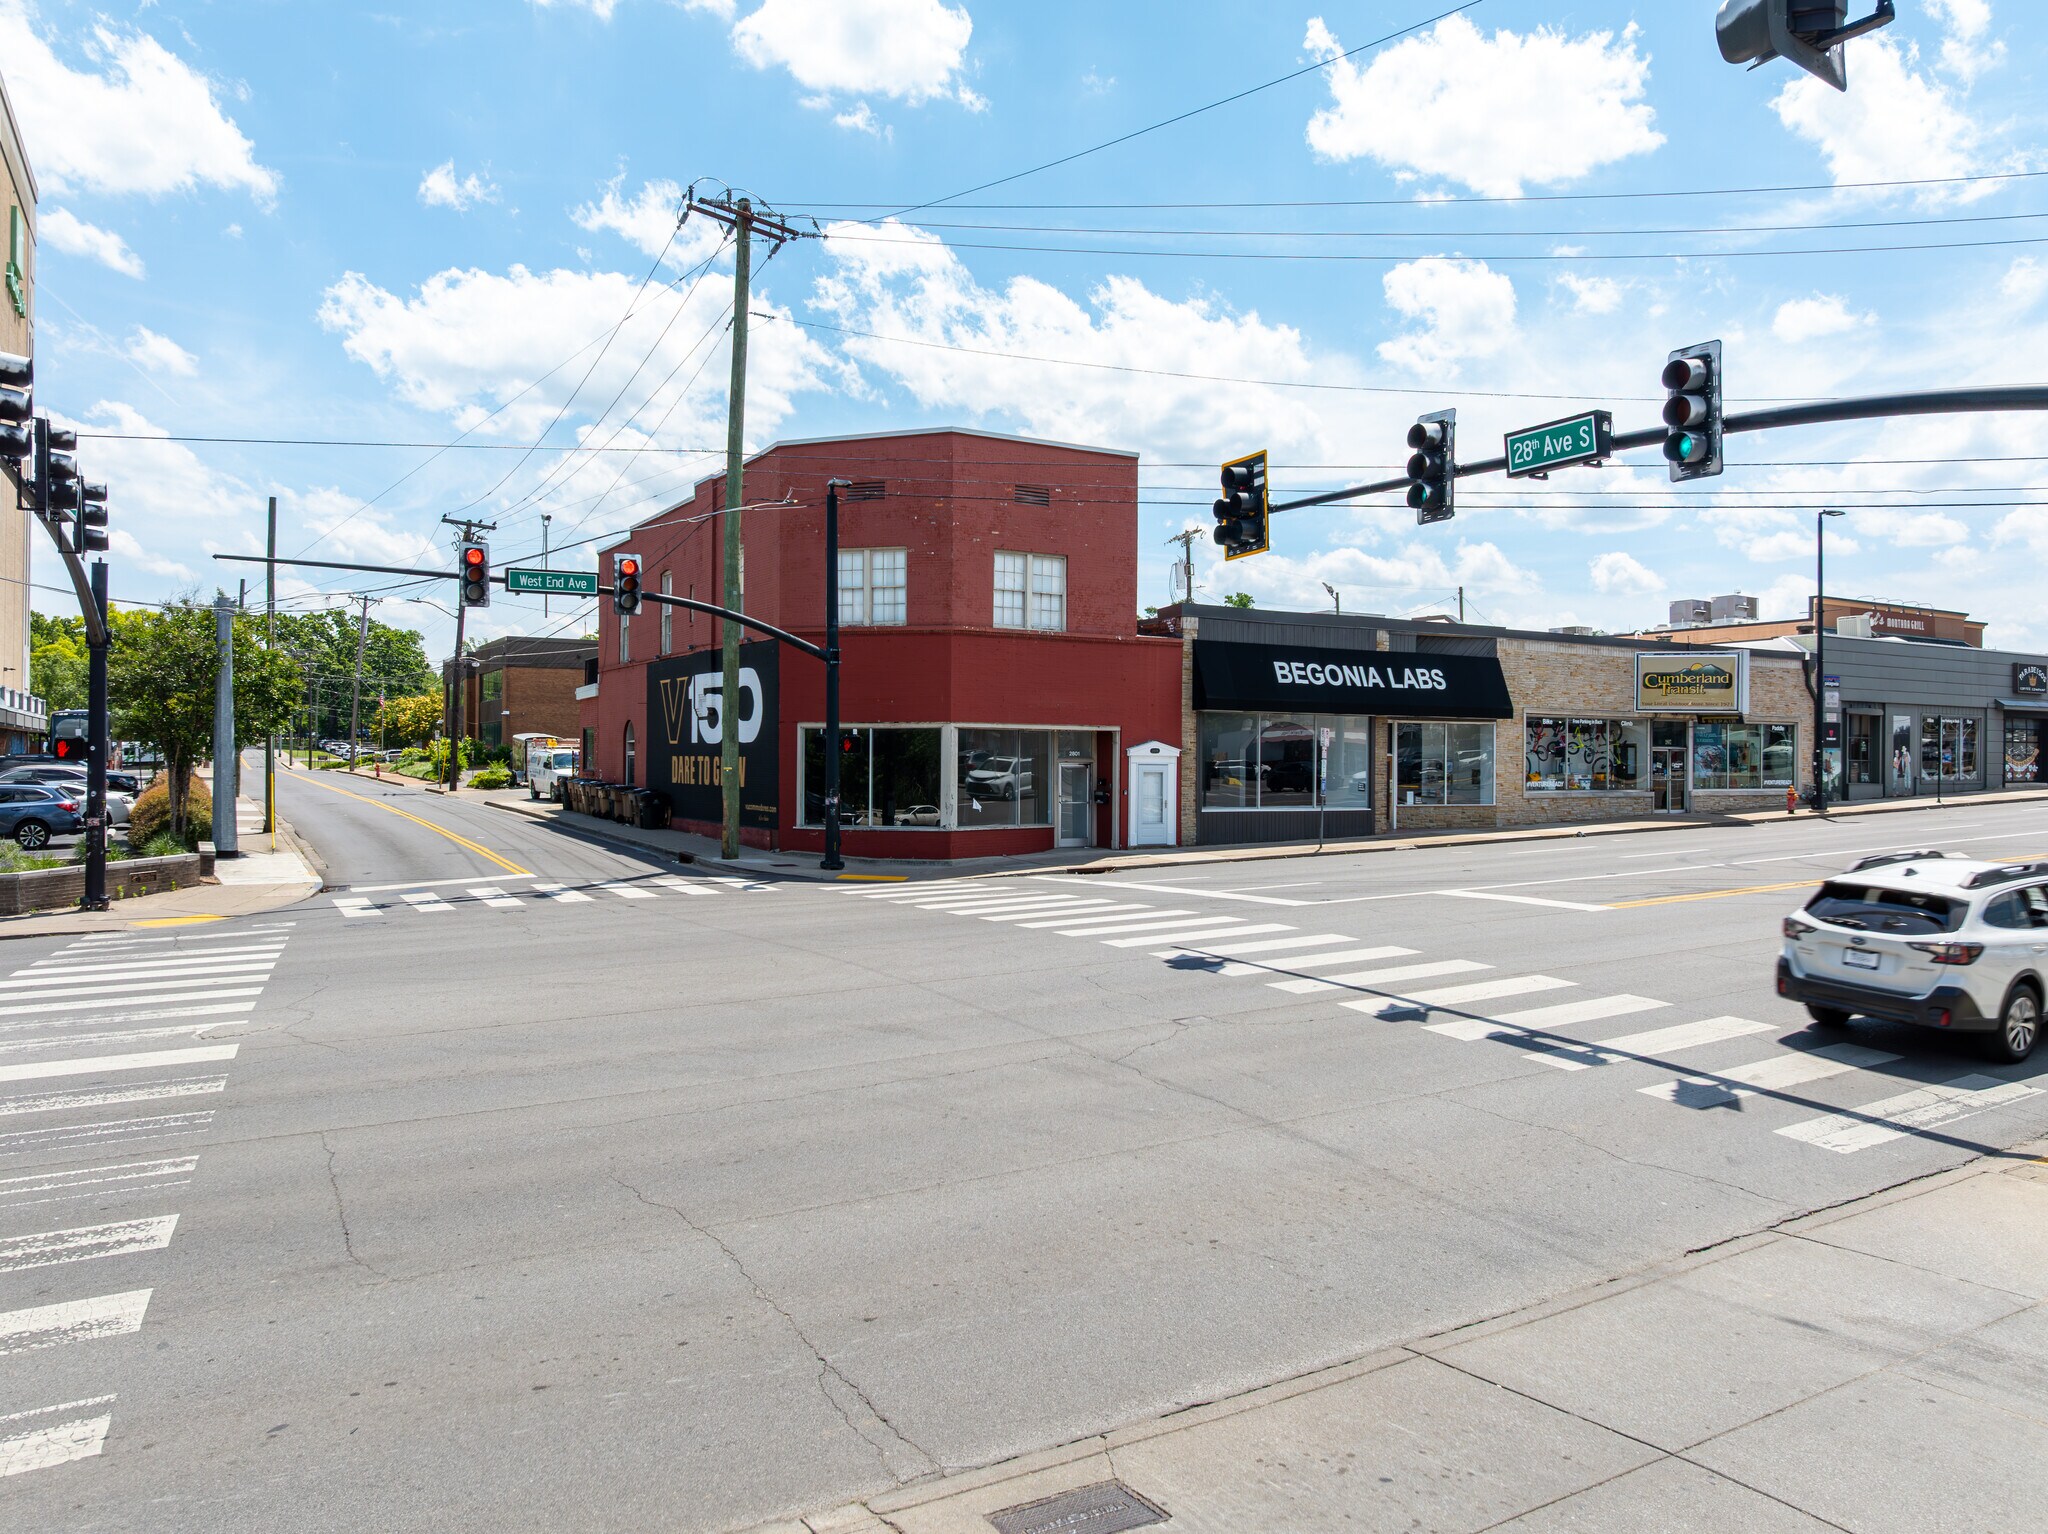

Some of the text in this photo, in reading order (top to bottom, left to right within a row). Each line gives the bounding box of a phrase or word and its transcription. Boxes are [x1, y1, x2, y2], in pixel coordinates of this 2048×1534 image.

[1513, 425, 1590, 464] 28th Ave S
[519, 574, 587, 589] West End Ave
[1886, 617, 1910, 629] MONTANA
[1911, 620, 1925, 631] GRILL
[1273, 661, 1447, 690] BEGONIA LABS
[1645, 672, 1730, 688] Cumberland
[1658, 683, 1706, 696] Transit
[671, 755, 746, 788] DARE TO GW
